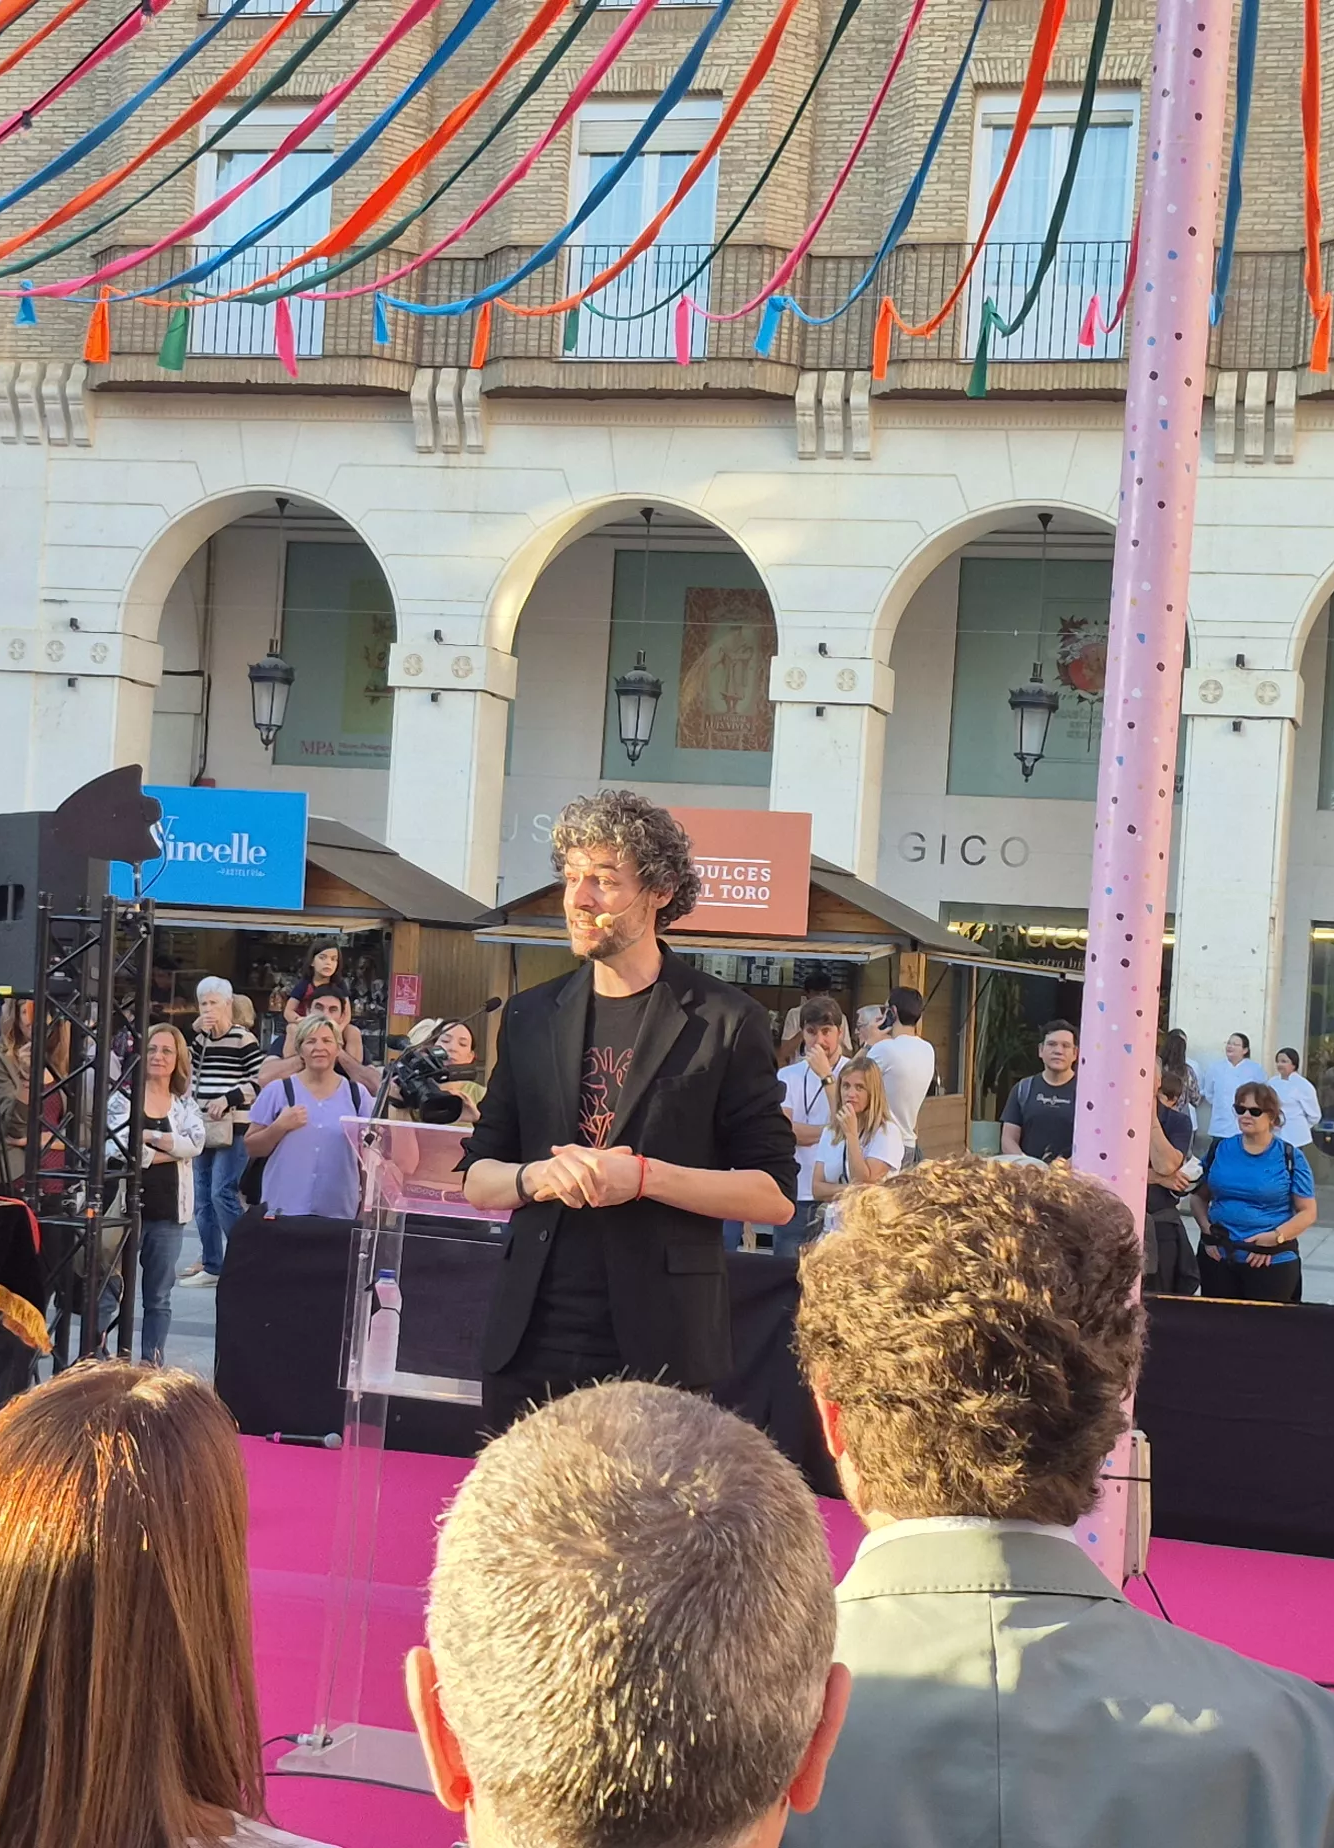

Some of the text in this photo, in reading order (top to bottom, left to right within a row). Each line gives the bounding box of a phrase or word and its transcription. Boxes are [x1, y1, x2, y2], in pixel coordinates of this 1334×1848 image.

[300, 740, 335, 756] MPA
[694, 864, 771, 882] DULCES
[719, 884, 770, 901] TORO
